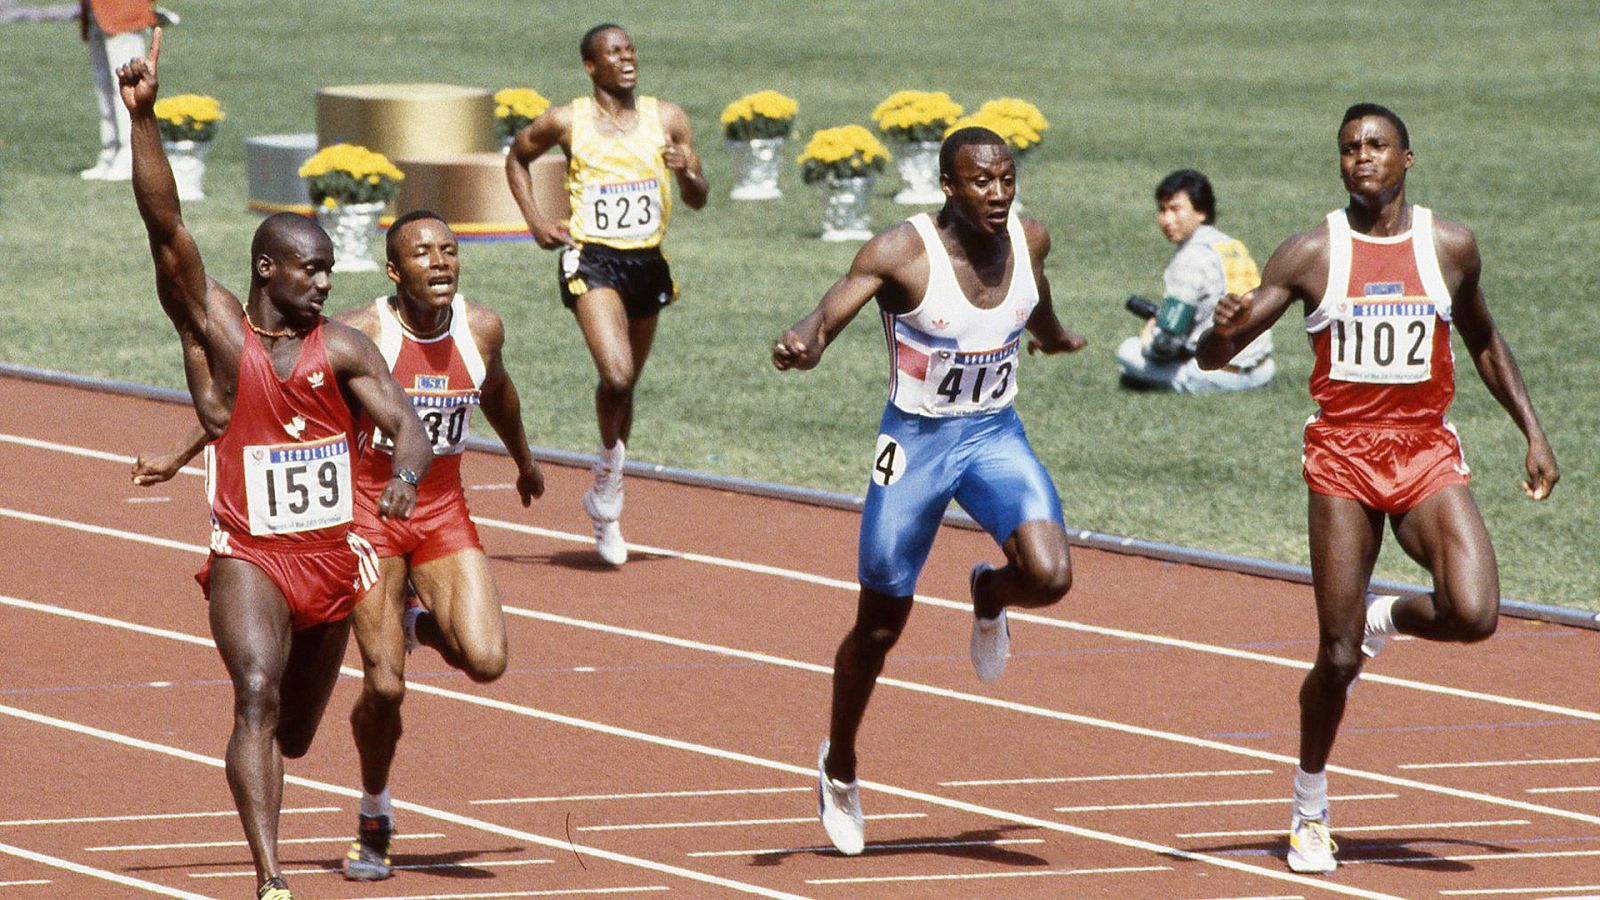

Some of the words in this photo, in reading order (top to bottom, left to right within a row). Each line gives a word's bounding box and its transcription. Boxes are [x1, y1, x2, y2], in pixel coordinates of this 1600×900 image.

[594, 195, 651, 231] 623
[1336, 320, 1426, 367] 1102
[418, 376, 446, 390] USA
[937, 362, 1012, 403] 413
[875, 441, 897, 485] 4
[265, 461, 340, 516] 159
